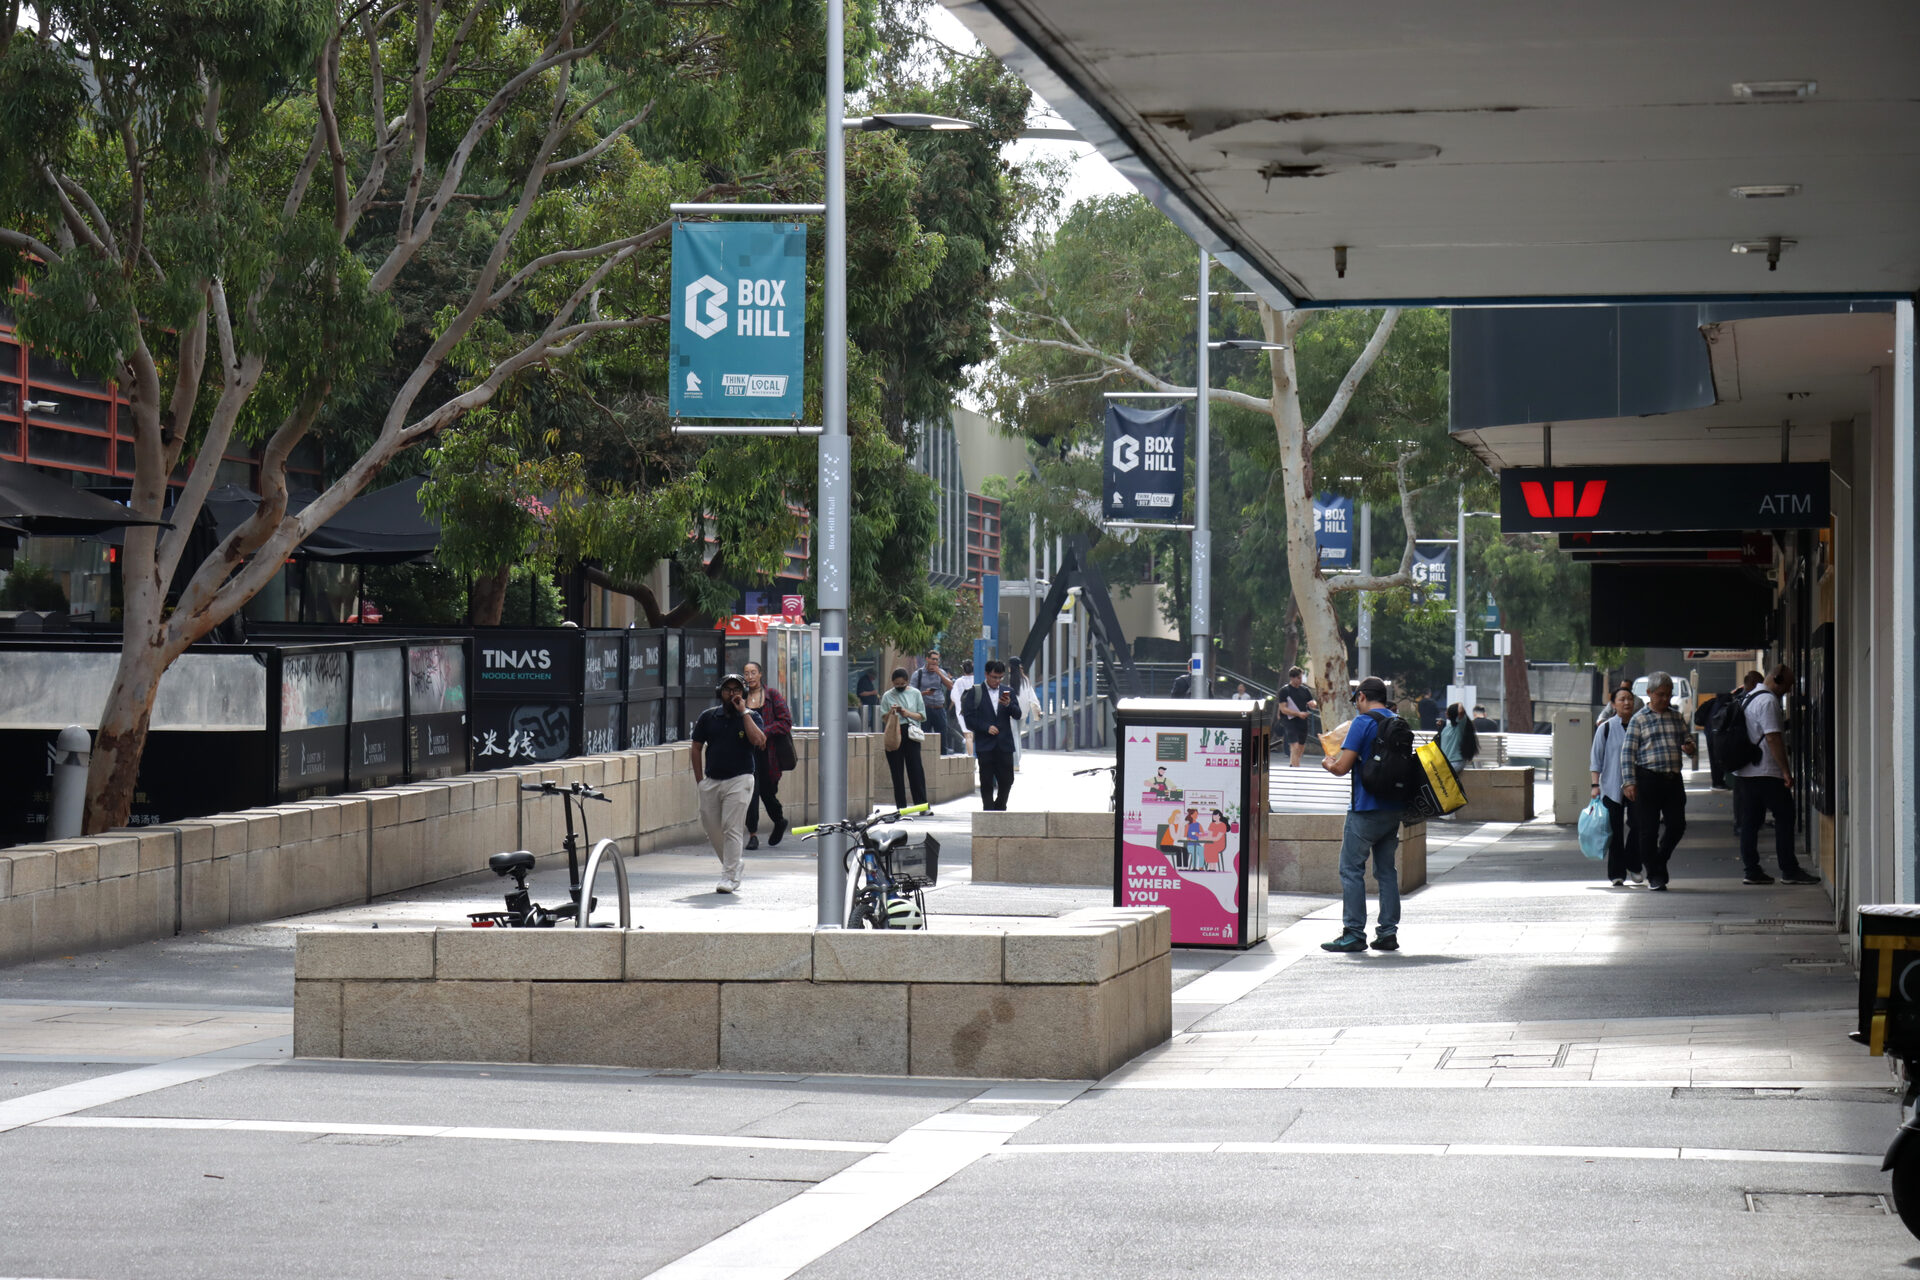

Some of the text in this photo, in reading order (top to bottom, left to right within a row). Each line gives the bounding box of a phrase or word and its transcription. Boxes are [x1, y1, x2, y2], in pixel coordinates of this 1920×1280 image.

[738, 279, 786, 307] BOX
[737, 309, 790, 337] HILL
[725, 375, 746, 384] THINK
[751, 379, 781, 391] LOCAL
[729, 386, 744, 395] BUY
[1144, 436, 1174, 453] BOX
[1144, 454, 1176, 471] HILL
[1758, 494, 1812, 515] ATM
[1325, 508, 1346, 521] BOX
[1324, 520, 1347, 533] HILL
[827, 534, 836, 550] Box
[1429, 563, 1446, 573] BOX
[1429, 572, 1447, 582] HILL
[482, 649, 552, 670] TINA'S
[482, 672, 552, 680] NOODLE KITCHEN
[472, 729, 537, 758] 米线
[1128, 878, 1181, 889] WHERE
[1128, 891, 1159, 902] YOU
